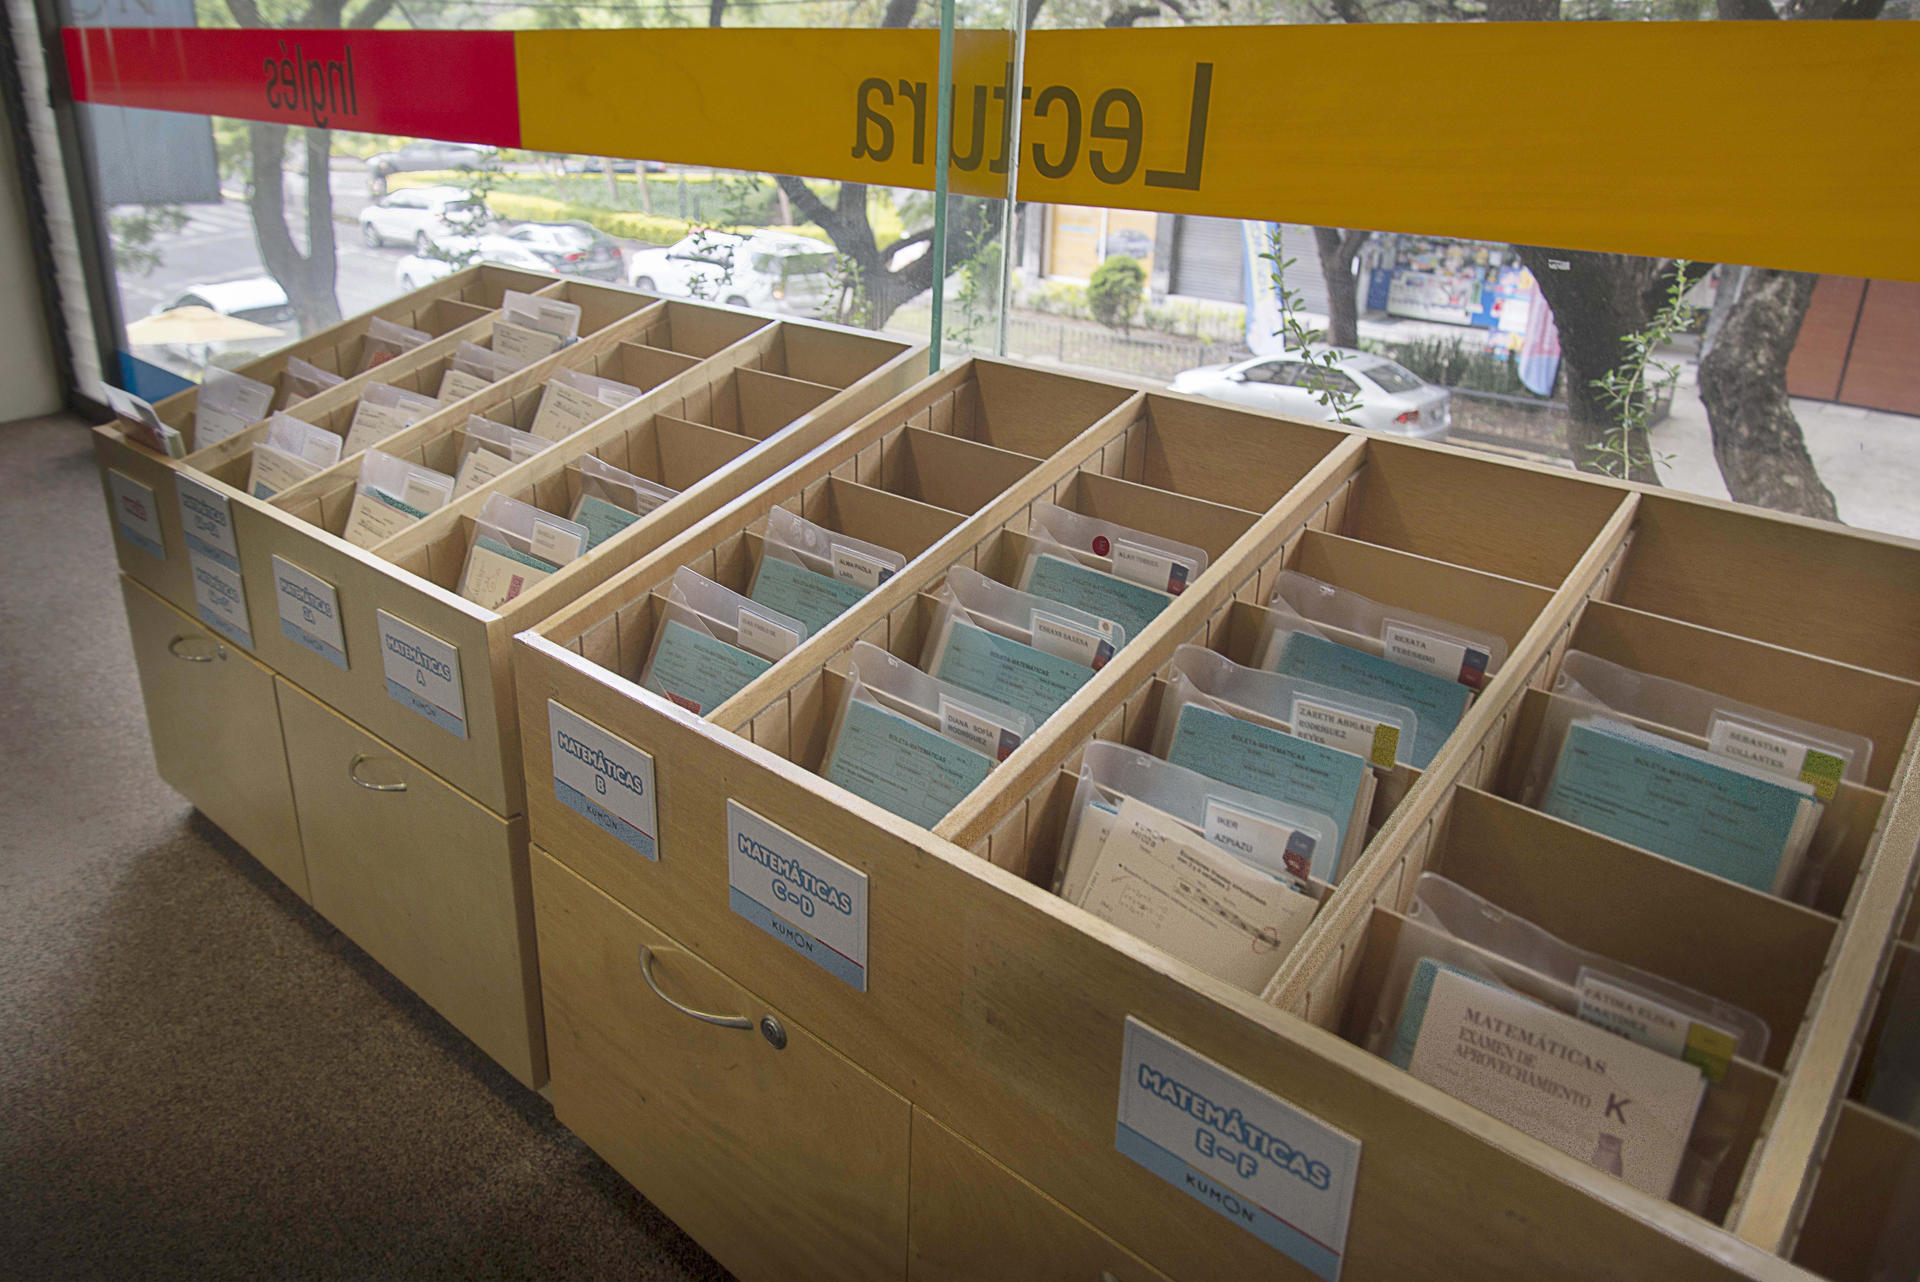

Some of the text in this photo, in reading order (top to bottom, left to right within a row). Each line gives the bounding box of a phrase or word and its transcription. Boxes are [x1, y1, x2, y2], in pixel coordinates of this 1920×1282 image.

[557, 729, 644, 796] MATEMÁTICAS
[595, 773, 607, 796] B
[586, 804, 619, 831] KUMON
[737, 831, 853, 917] MATEMÁTICAS
[771, 919, 814, 954] KUMON
[1458, 1025, 1515, 1060] EXAMEN
[1464, 1006, 1608, 1076] MATEMÁTICAS
[1137, 1062, 1332, 1191] MATEMÁTICAS
[1604, 1092, 1631, 1126] K
[1185, 1172, 1255, 1223] KUMON
